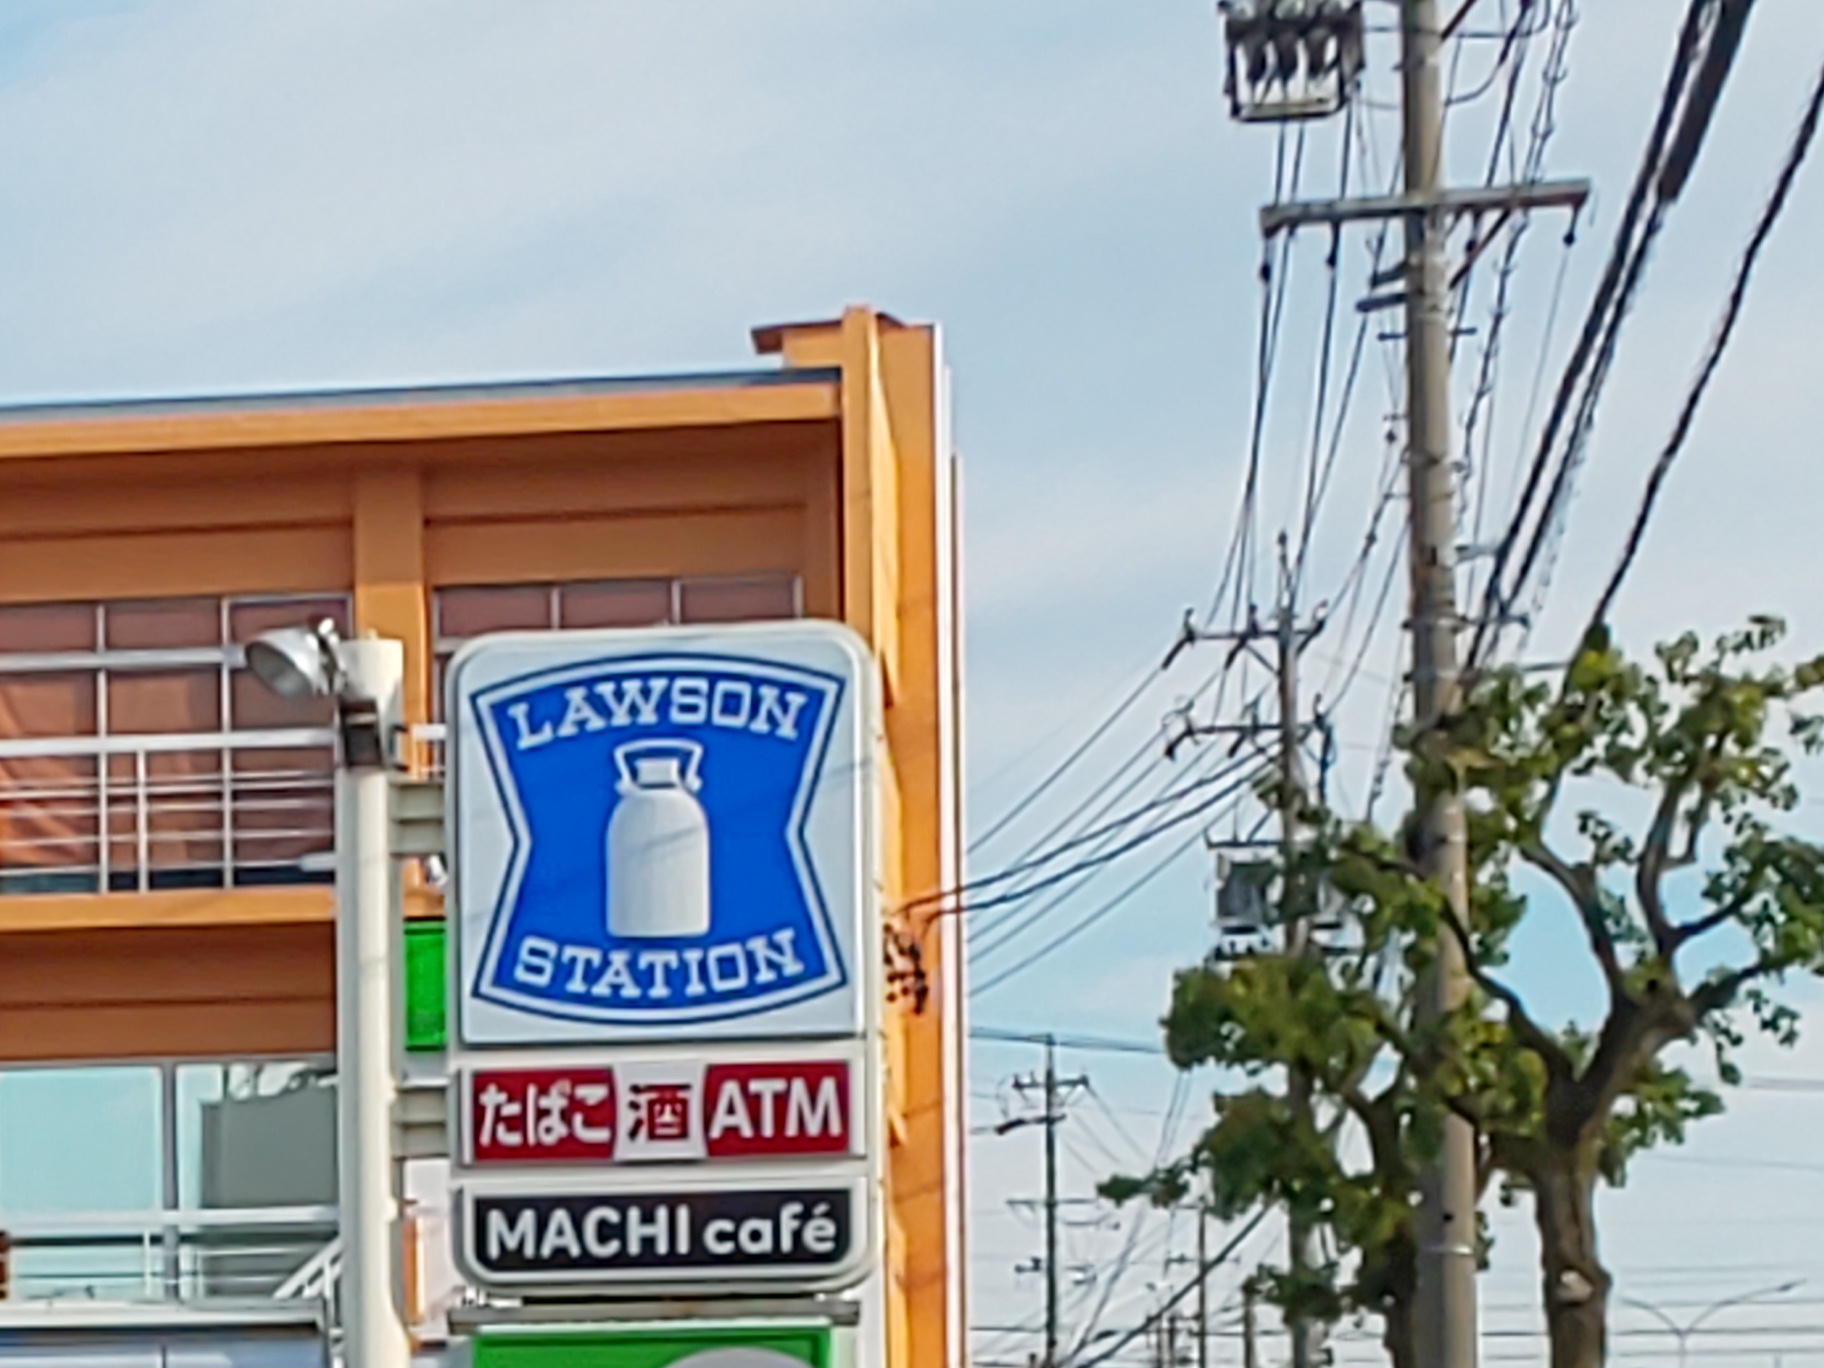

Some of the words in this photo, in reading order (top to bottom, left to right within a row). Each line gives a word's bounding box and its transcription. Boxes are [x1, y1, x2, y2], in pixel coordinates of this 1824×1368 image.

[507, 676, 808, 750] LAWSON
[513, 929, 806, 1000] STATION
[478, 1078, 612, 1148] たばこ
[627, 1083, 693, 1143] 酒
[708, 1075, 843, 1139] ATM
[485, 1204, 691, 1260] MACHI
[702, 1200, 837, 1255] café
